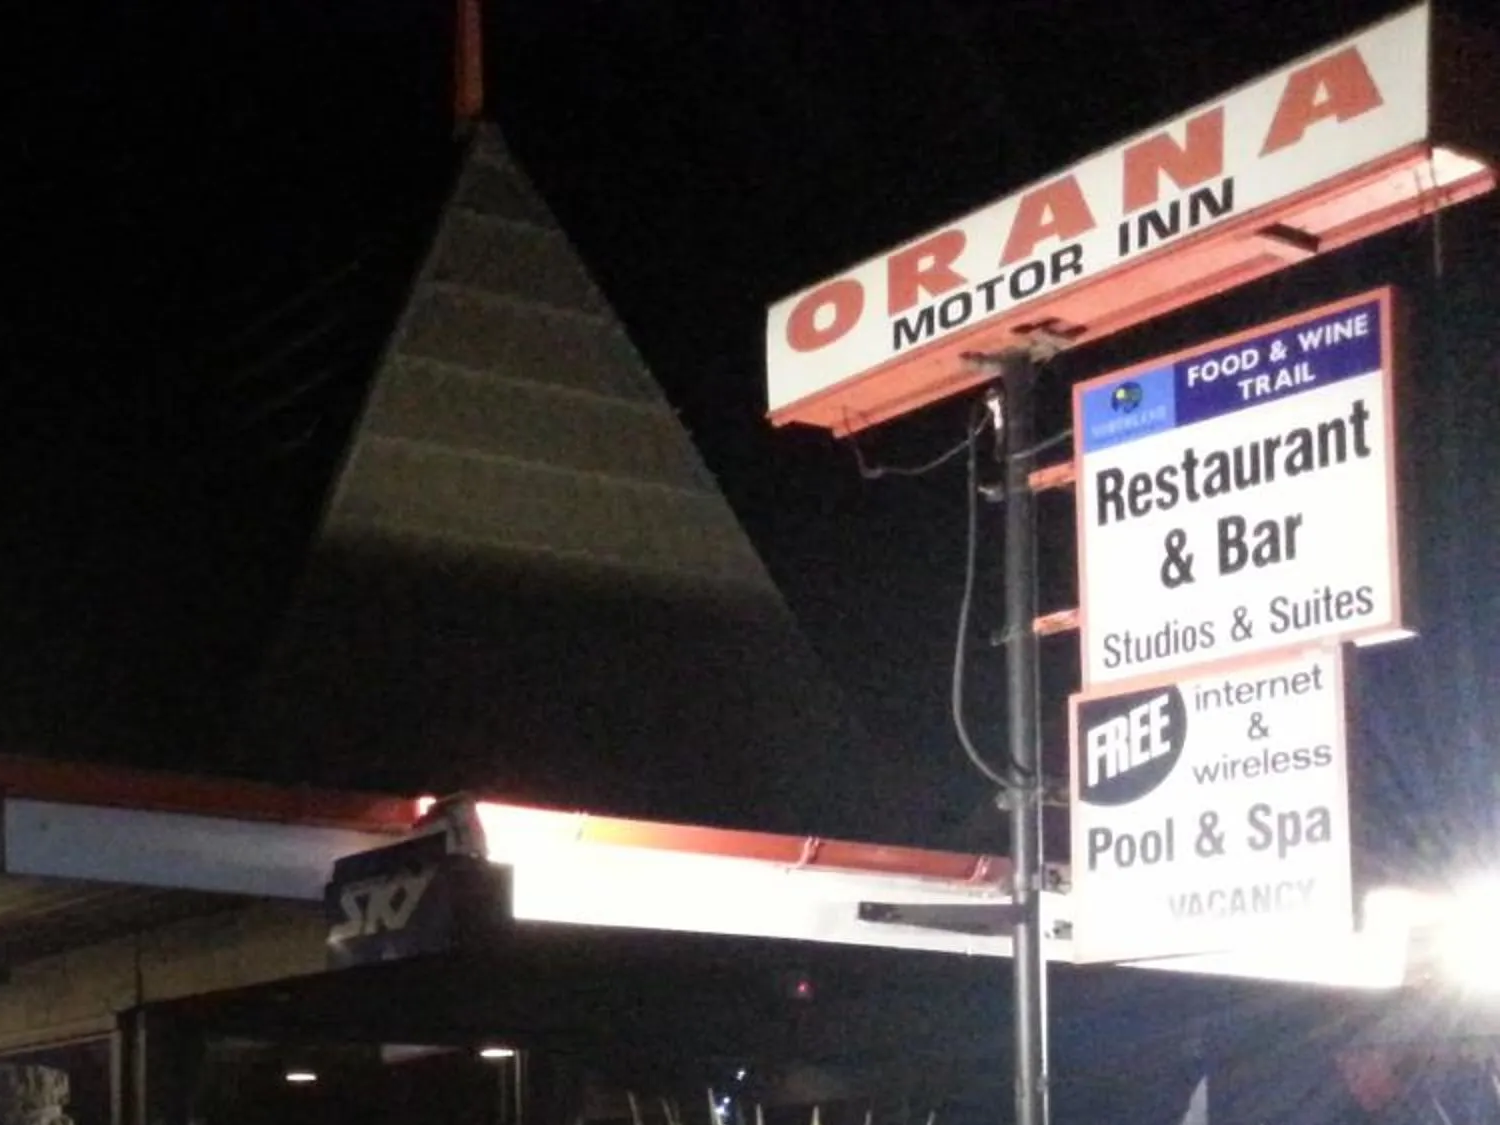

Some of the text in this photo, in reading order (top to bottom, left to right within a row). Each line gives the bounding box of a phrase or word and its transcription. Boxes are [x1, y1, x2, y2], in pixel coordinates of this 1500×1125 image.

[784, 46, 1384, 353] ORANA
[892, 178, 1235, 351] MOTOR INN
[1187, 313, 1369, 388] FOOD & WINE
[1238, 362, 1316, 401] TRAIL
[1096, 399, 1371, 527] Restaurant
[1160, 513, 1303, 590] & Bar
[1103, 584, 1375, 669] Studios & Suites
[1087, 664, 1324, 788] FREE internet
[1192, 743, 1333, 785] wireless
[1247, 712, 1270, 741] &
[1088, 803, 1332, 872] Pool & Spa
[1167, 878, 1316, 921] VACANCY
